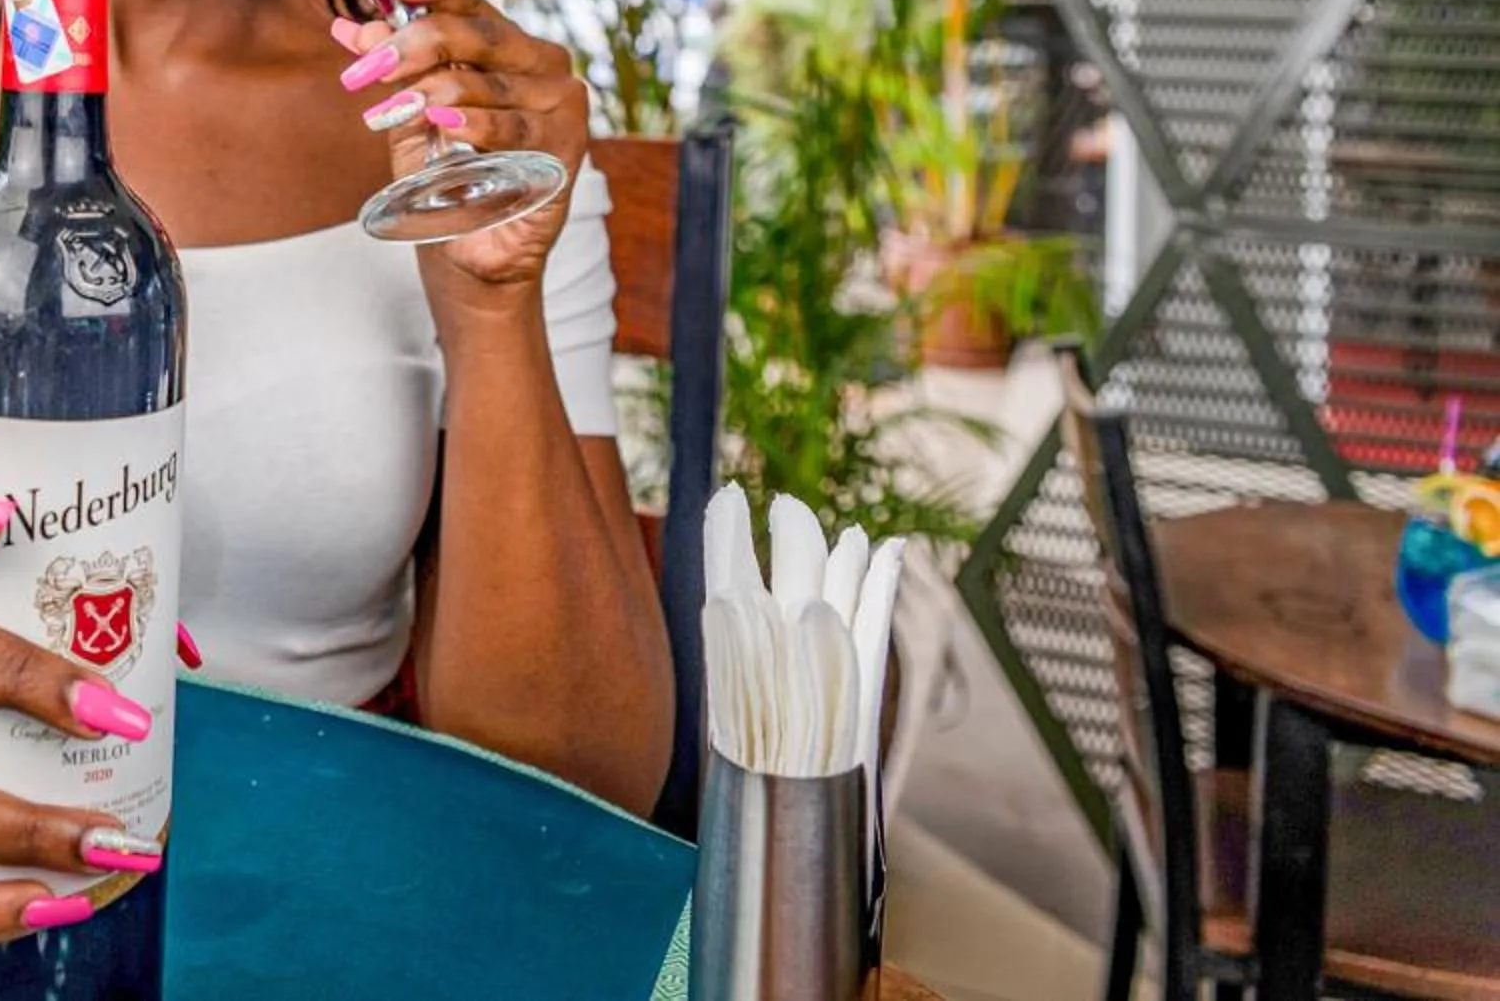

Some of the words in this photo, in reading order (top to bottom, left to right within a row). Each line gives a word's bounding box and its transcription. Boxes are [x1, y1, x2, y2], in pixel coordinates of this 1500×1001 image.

[4, 451, 177, 546] Nederburg
[61, 742, 132, 767] MERLOT
[83, 768, 114, 784] 2020
